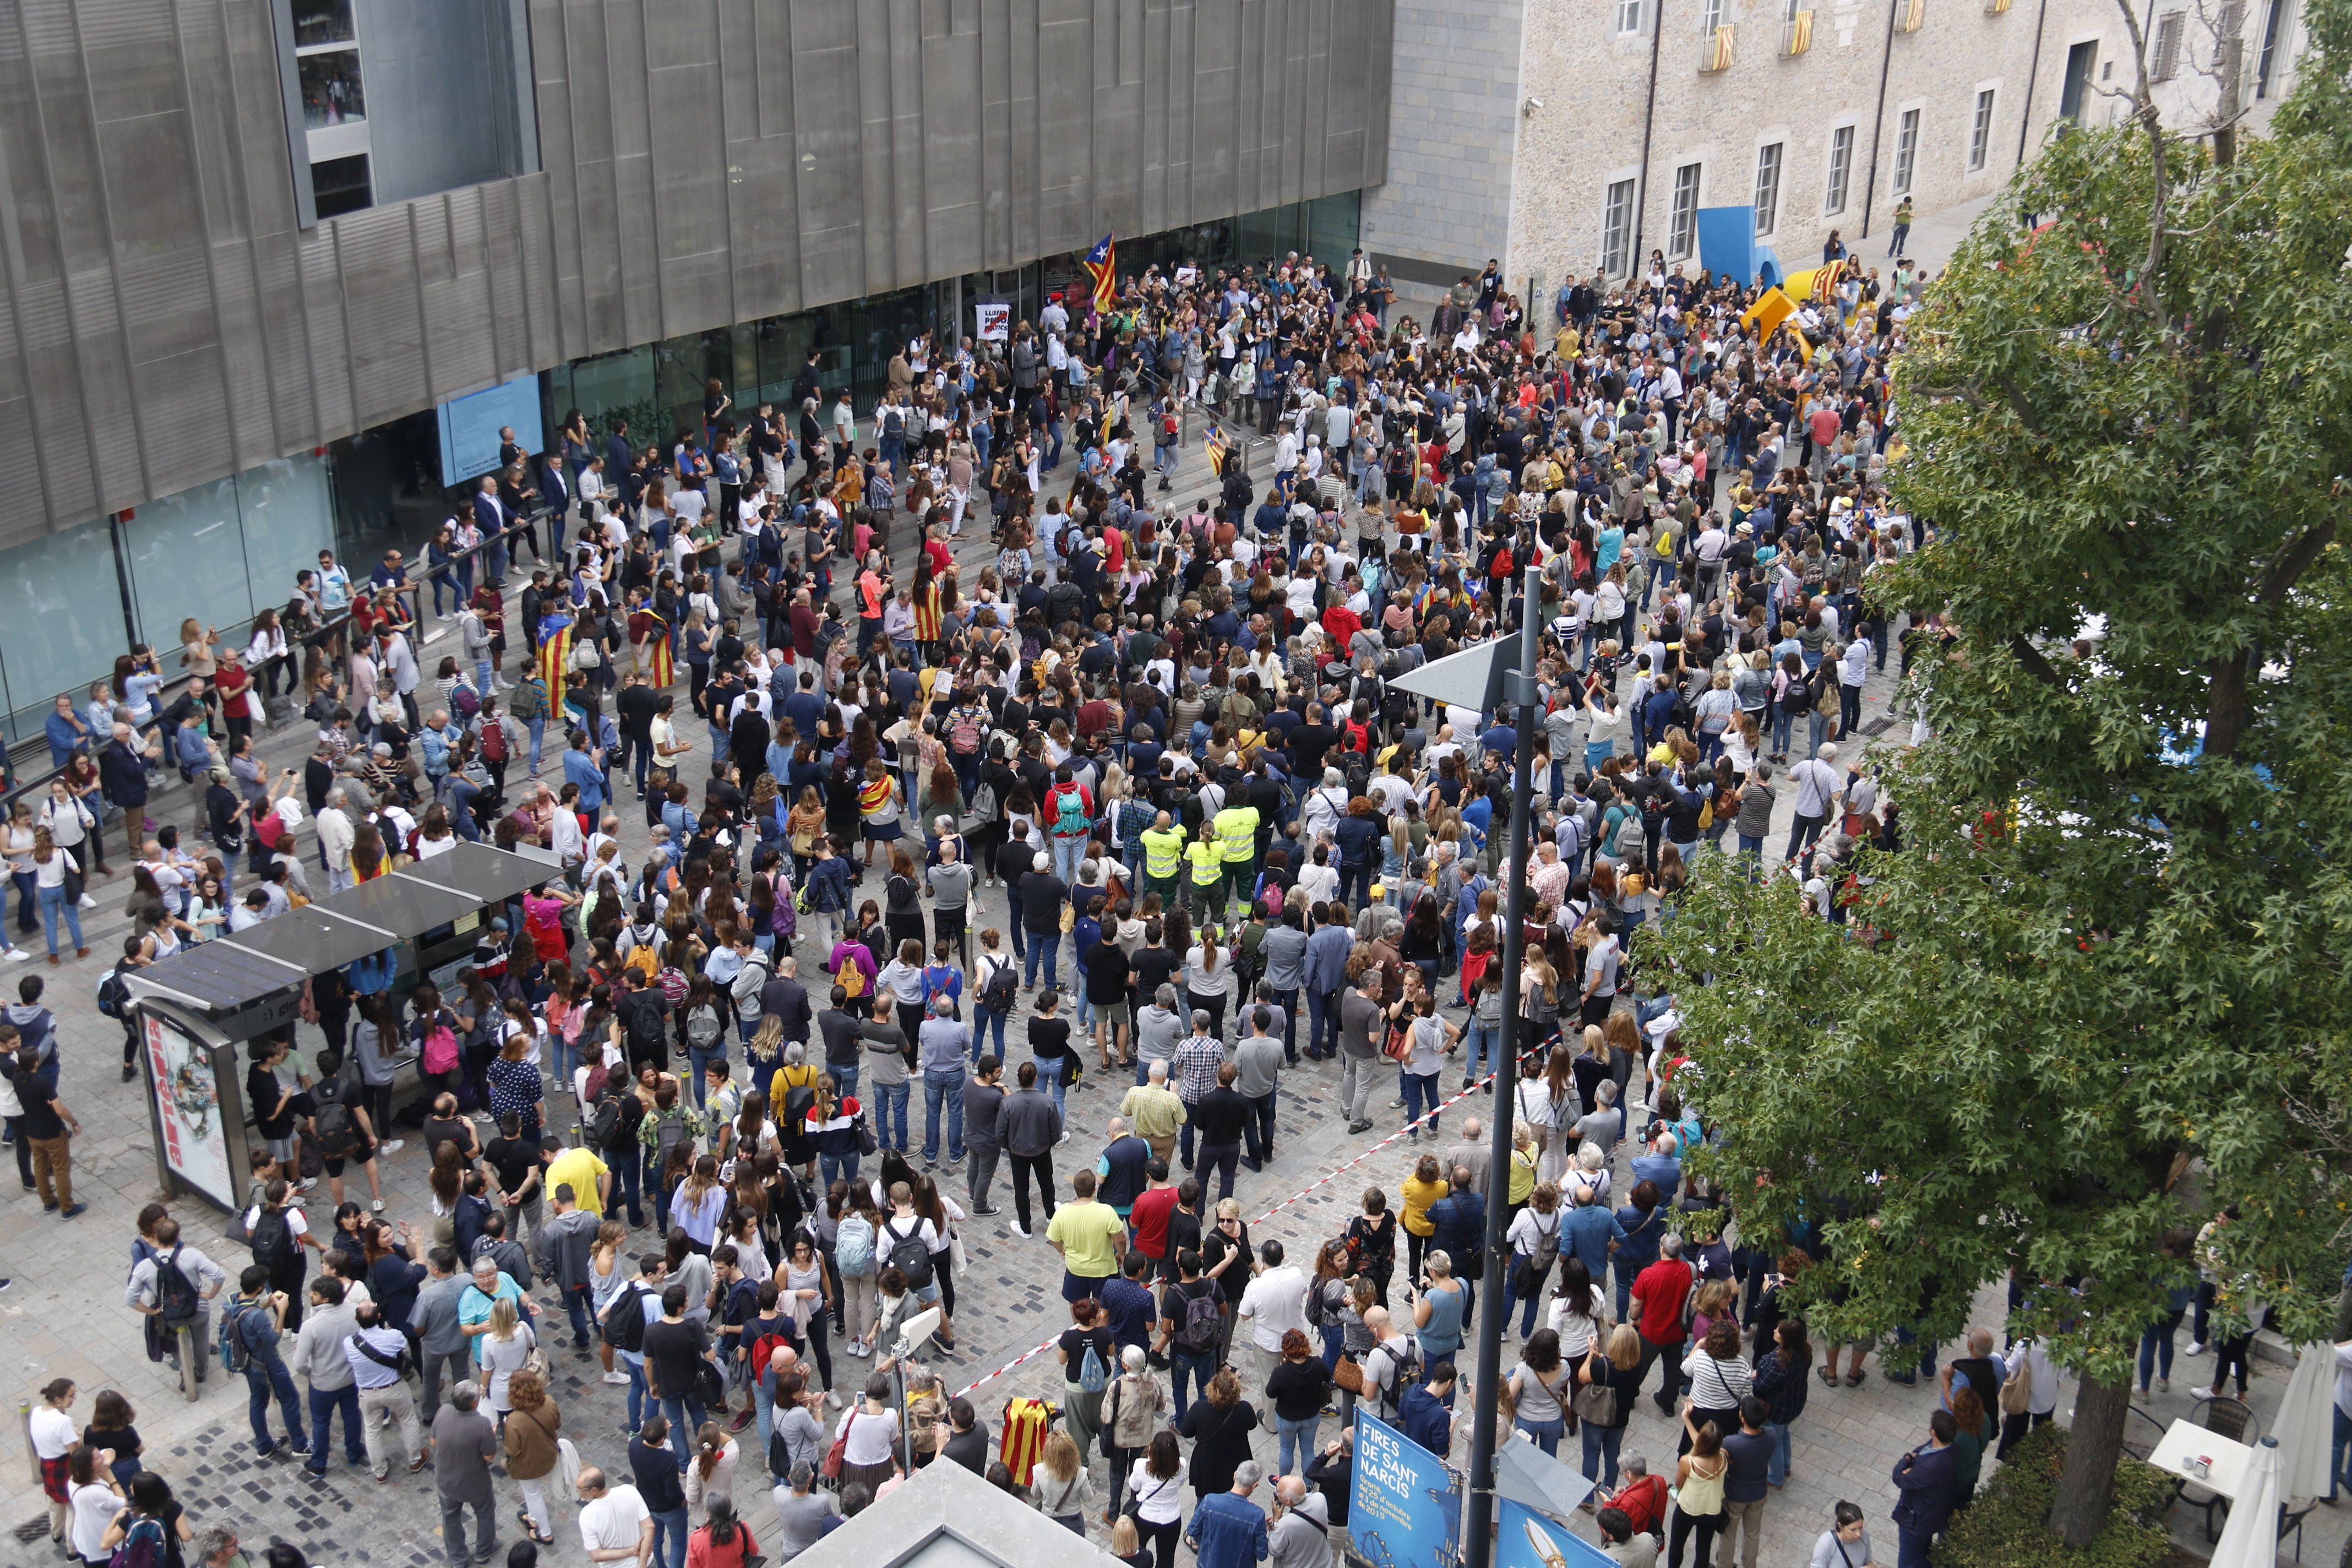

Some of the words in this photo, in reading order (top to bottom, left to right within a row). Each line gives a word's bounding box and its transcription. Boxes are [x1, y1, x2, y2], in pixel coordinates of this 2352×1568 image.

[2162, 748, 2191, 765] SANT
[1362, 1422, 1400, 1457] FIRES
[1362, 1439, 1379, 1462] DE
[1382, 1452, 1418, 1487] SANT
[1360, 1456, 1409, 1499] NARCÍS
[1360, 1474, 1382, 1494] Girona,
[1359, 1483, 1368, 1494] del
[1368, 1489, 1379, 1500] 25
[1358, 1499, 1365, 1509] de
[1366, 1505, 1385, 1520] 2019
[1370, 1500, 1379, 1509] de
[1380, 1505, 1412, 1531] novembre
